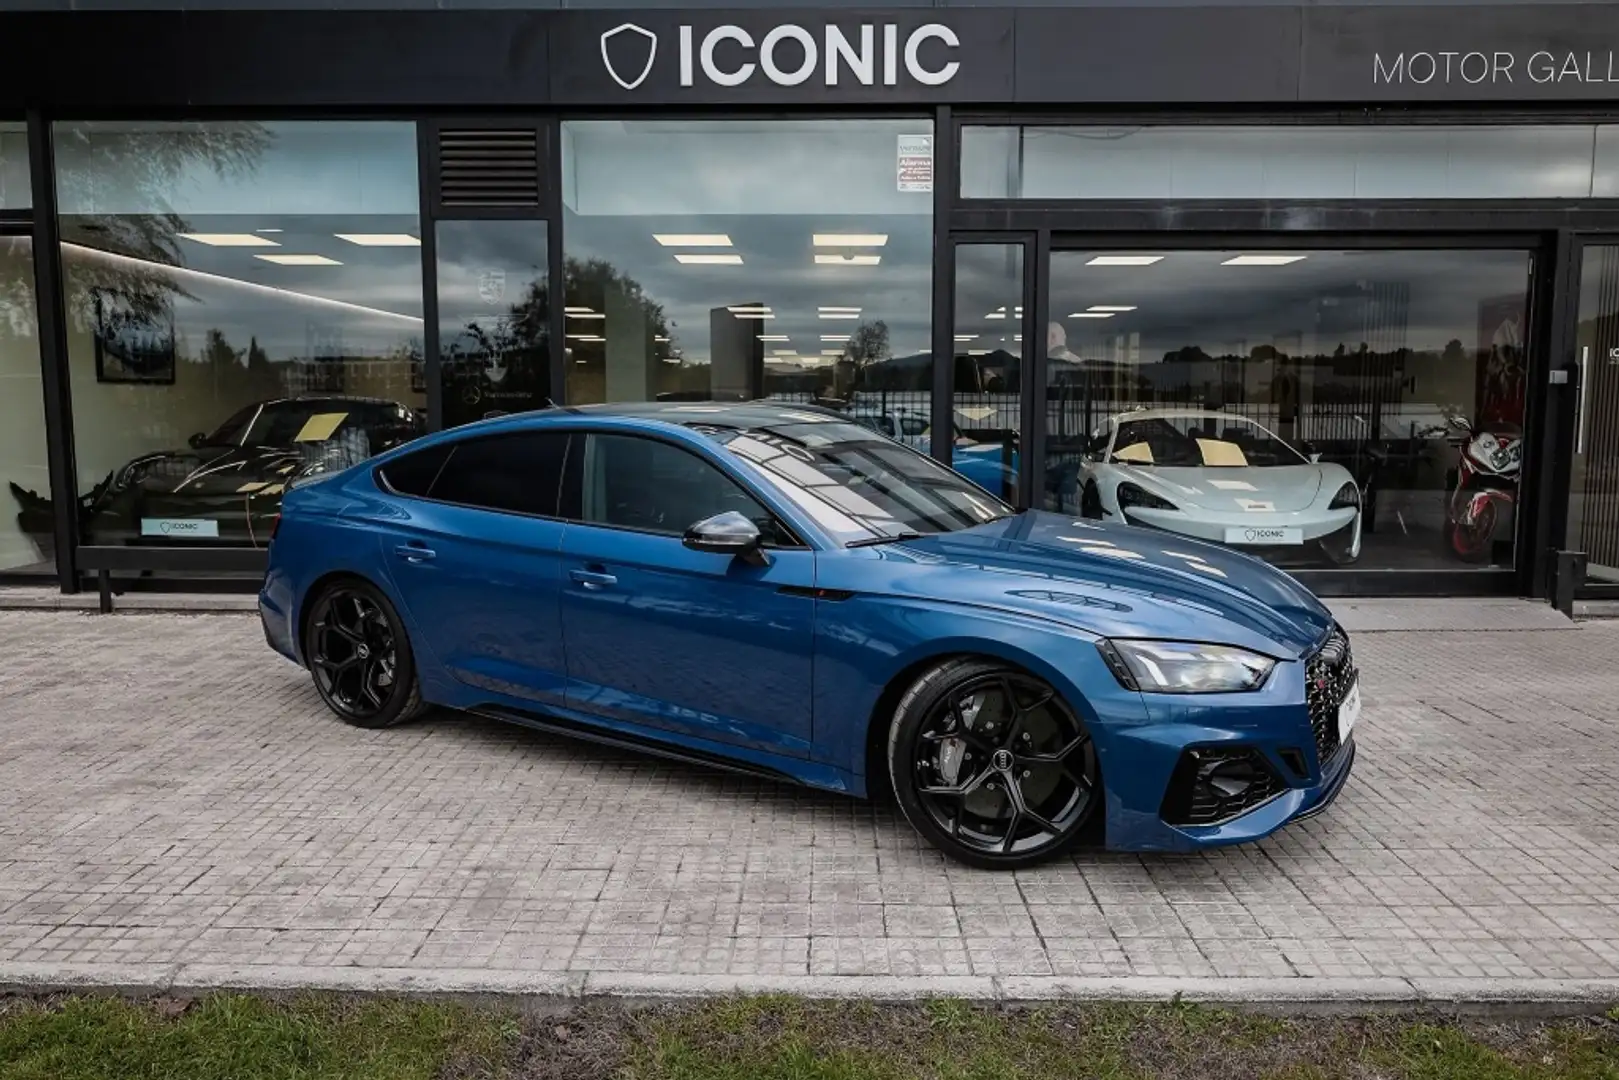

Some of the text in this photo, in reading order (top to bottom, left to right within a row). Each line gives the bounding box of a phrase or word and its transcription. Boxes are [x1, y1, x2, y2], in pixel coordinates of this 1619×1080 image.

[679, 23, 961, 86] ICONIC
[1373, 50, 1619, 84] MOTOR GALL
